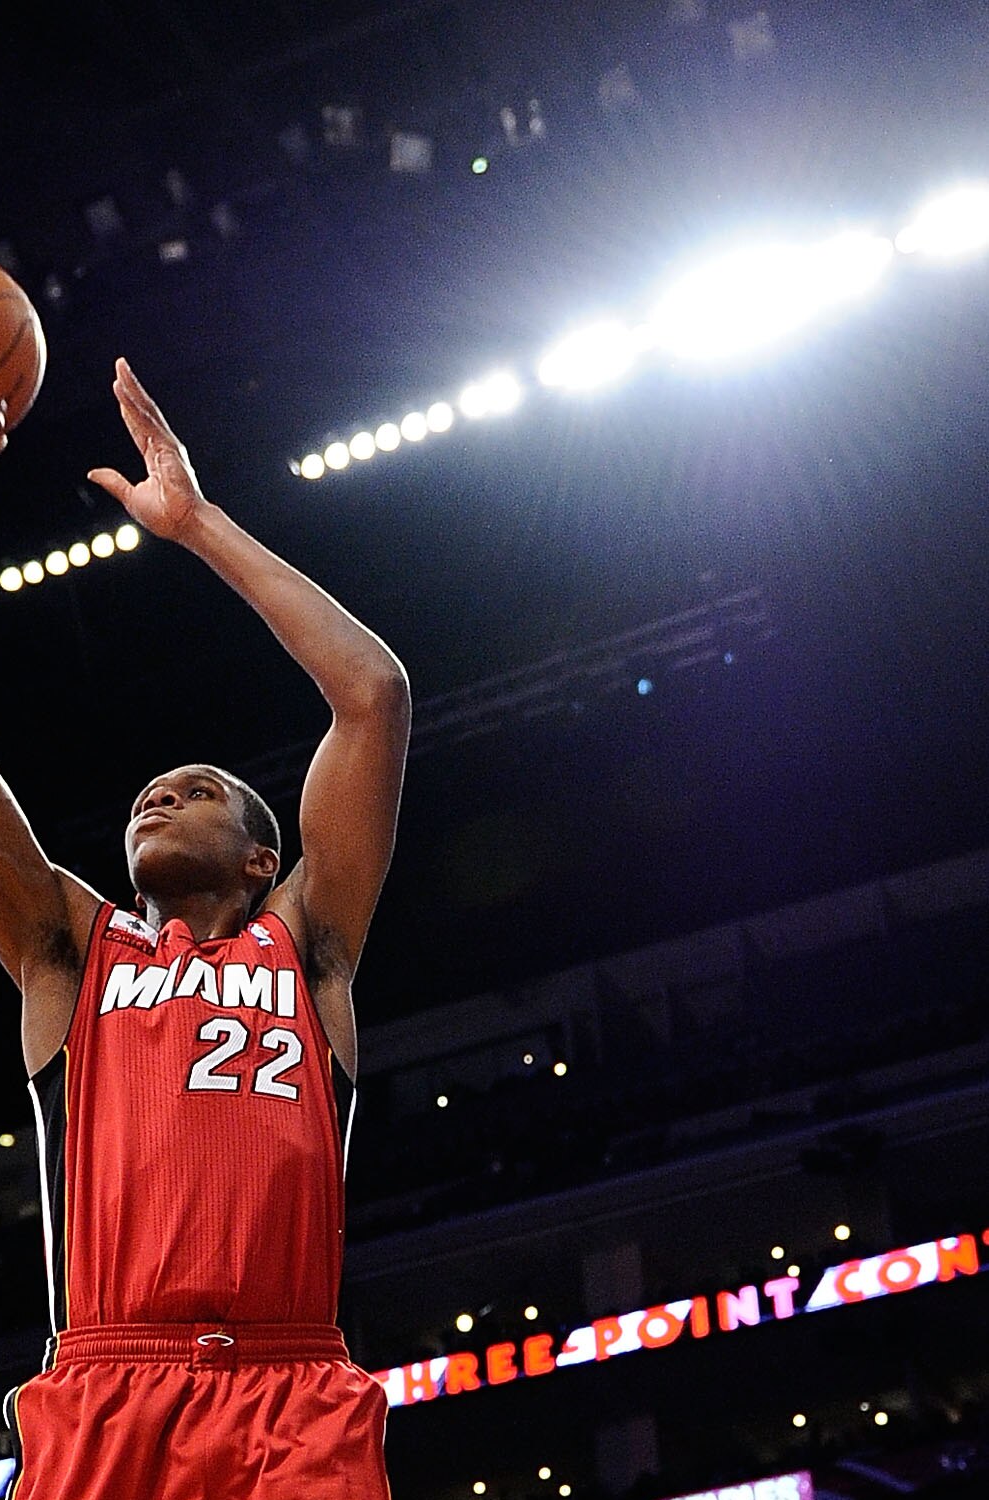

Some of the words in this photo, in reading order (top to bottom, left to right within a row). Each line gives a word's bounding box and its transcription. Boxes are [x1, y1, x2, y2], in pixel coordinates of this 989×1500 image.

[99, 953, 296, 1019] MIAMI
[187, 1015, 304, 1101] 22
[833, 1229, 989, 1305] CON
